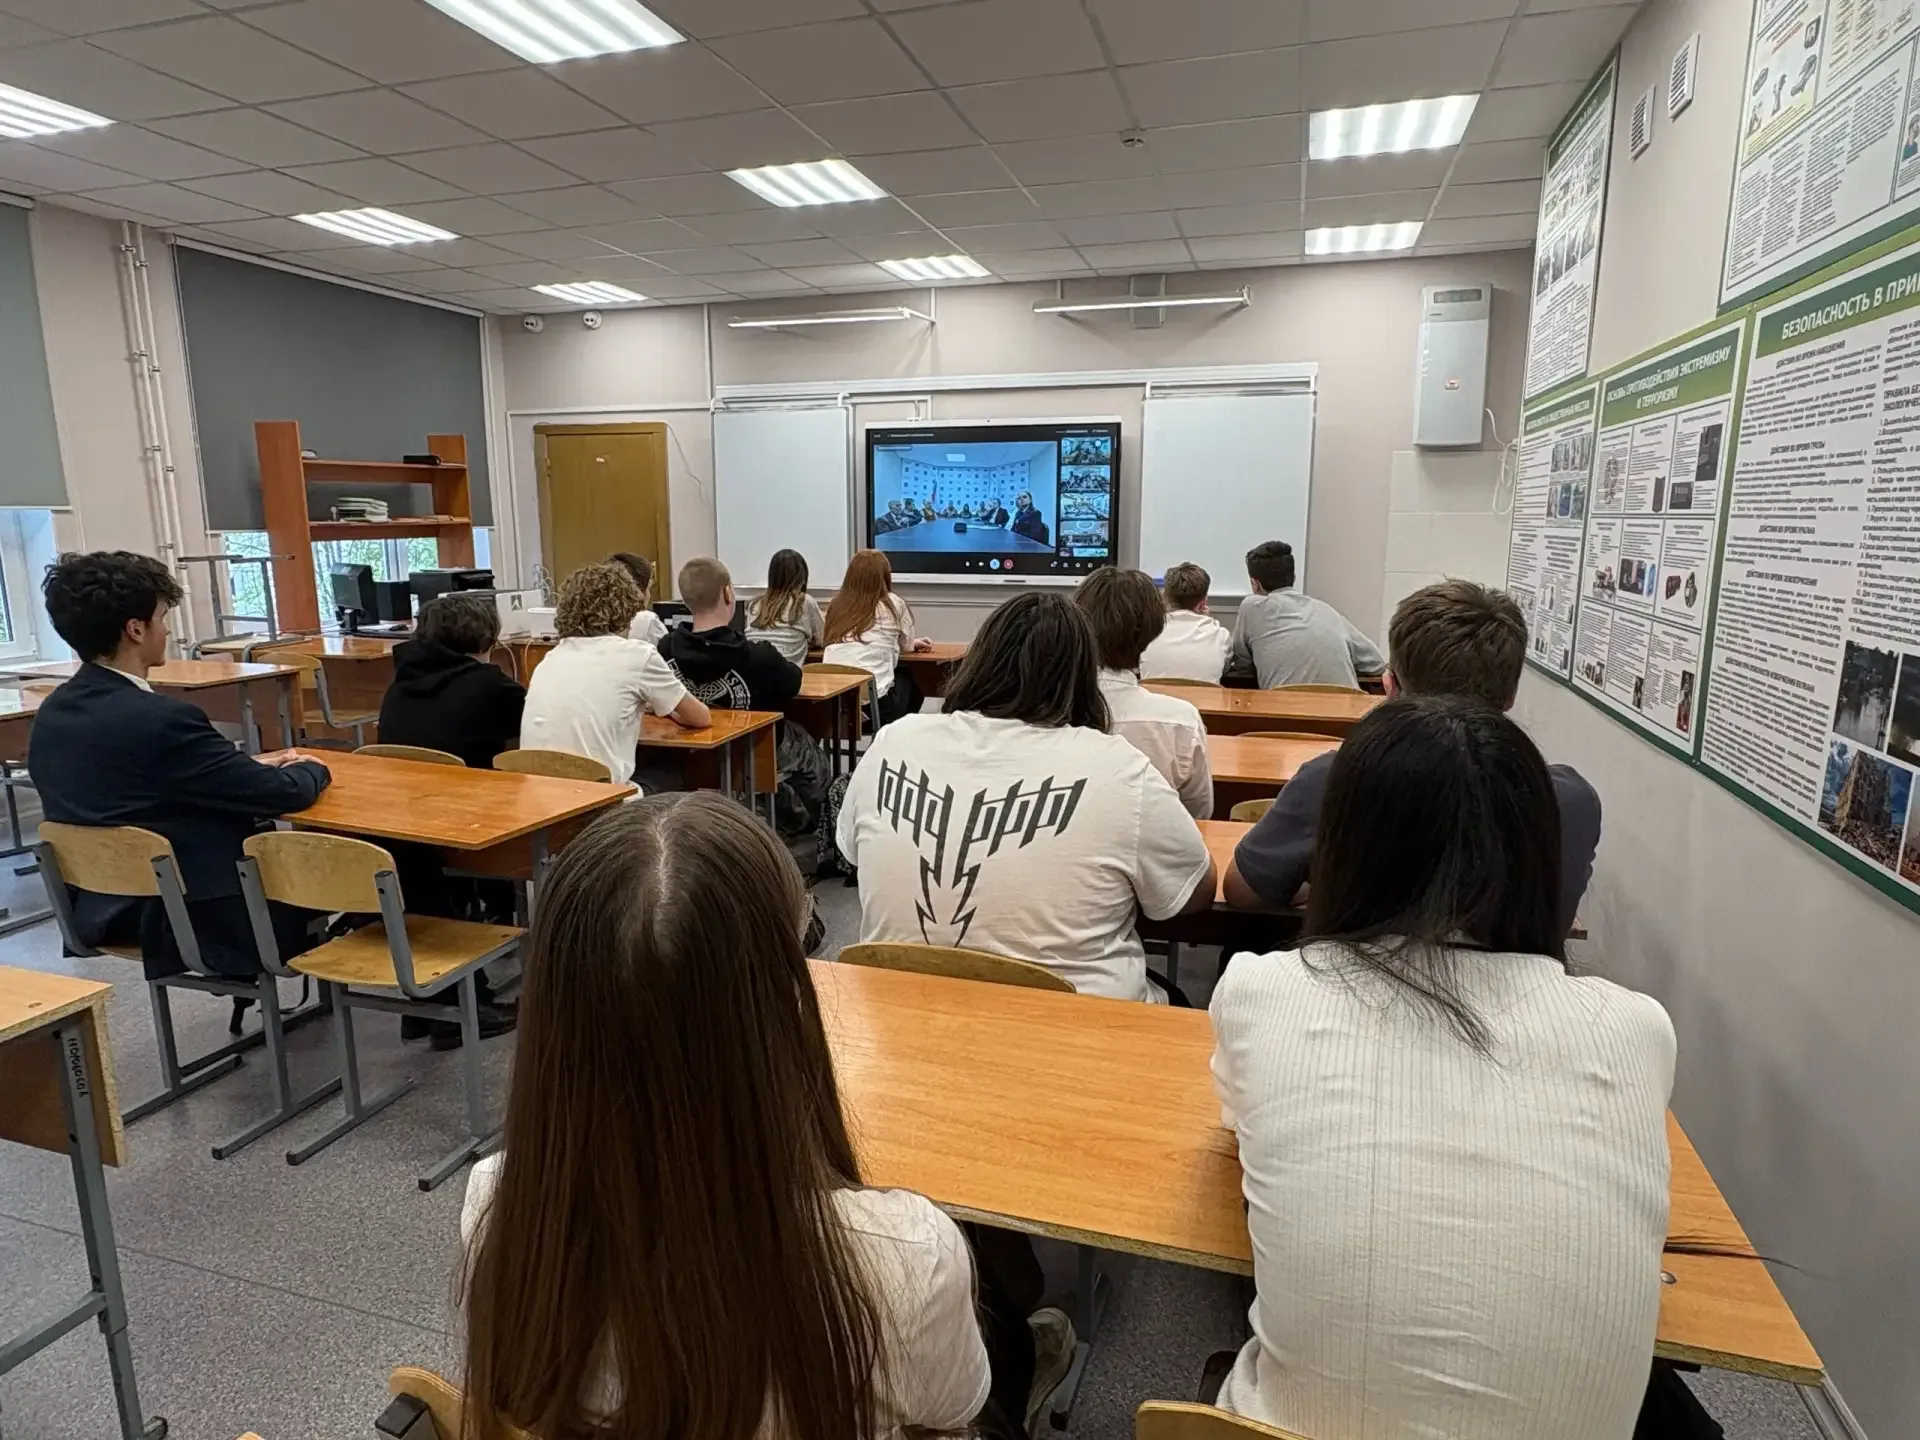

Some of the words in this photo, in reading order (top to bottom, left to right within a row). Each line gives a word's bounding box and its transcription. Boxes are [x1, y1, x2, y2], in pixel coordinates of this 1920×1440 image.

[1781, 292, 1871, 340] БЕЗОПАСНОСТЬ
[1872, 286, 1883, 307] В
[1885, 272, 1920, 303] ПРИ
[1606, 386, 1627, 403] ОСНОВЫ
[1626, 366, 1680, 397] ПРОТИВОДЕЙСТВИЯ
[1679, 345, 1732, 377] ЭКСТРЕМИЗМУ
[1641, 385, 1680, 408] ТЕРРОРИЗМУ
